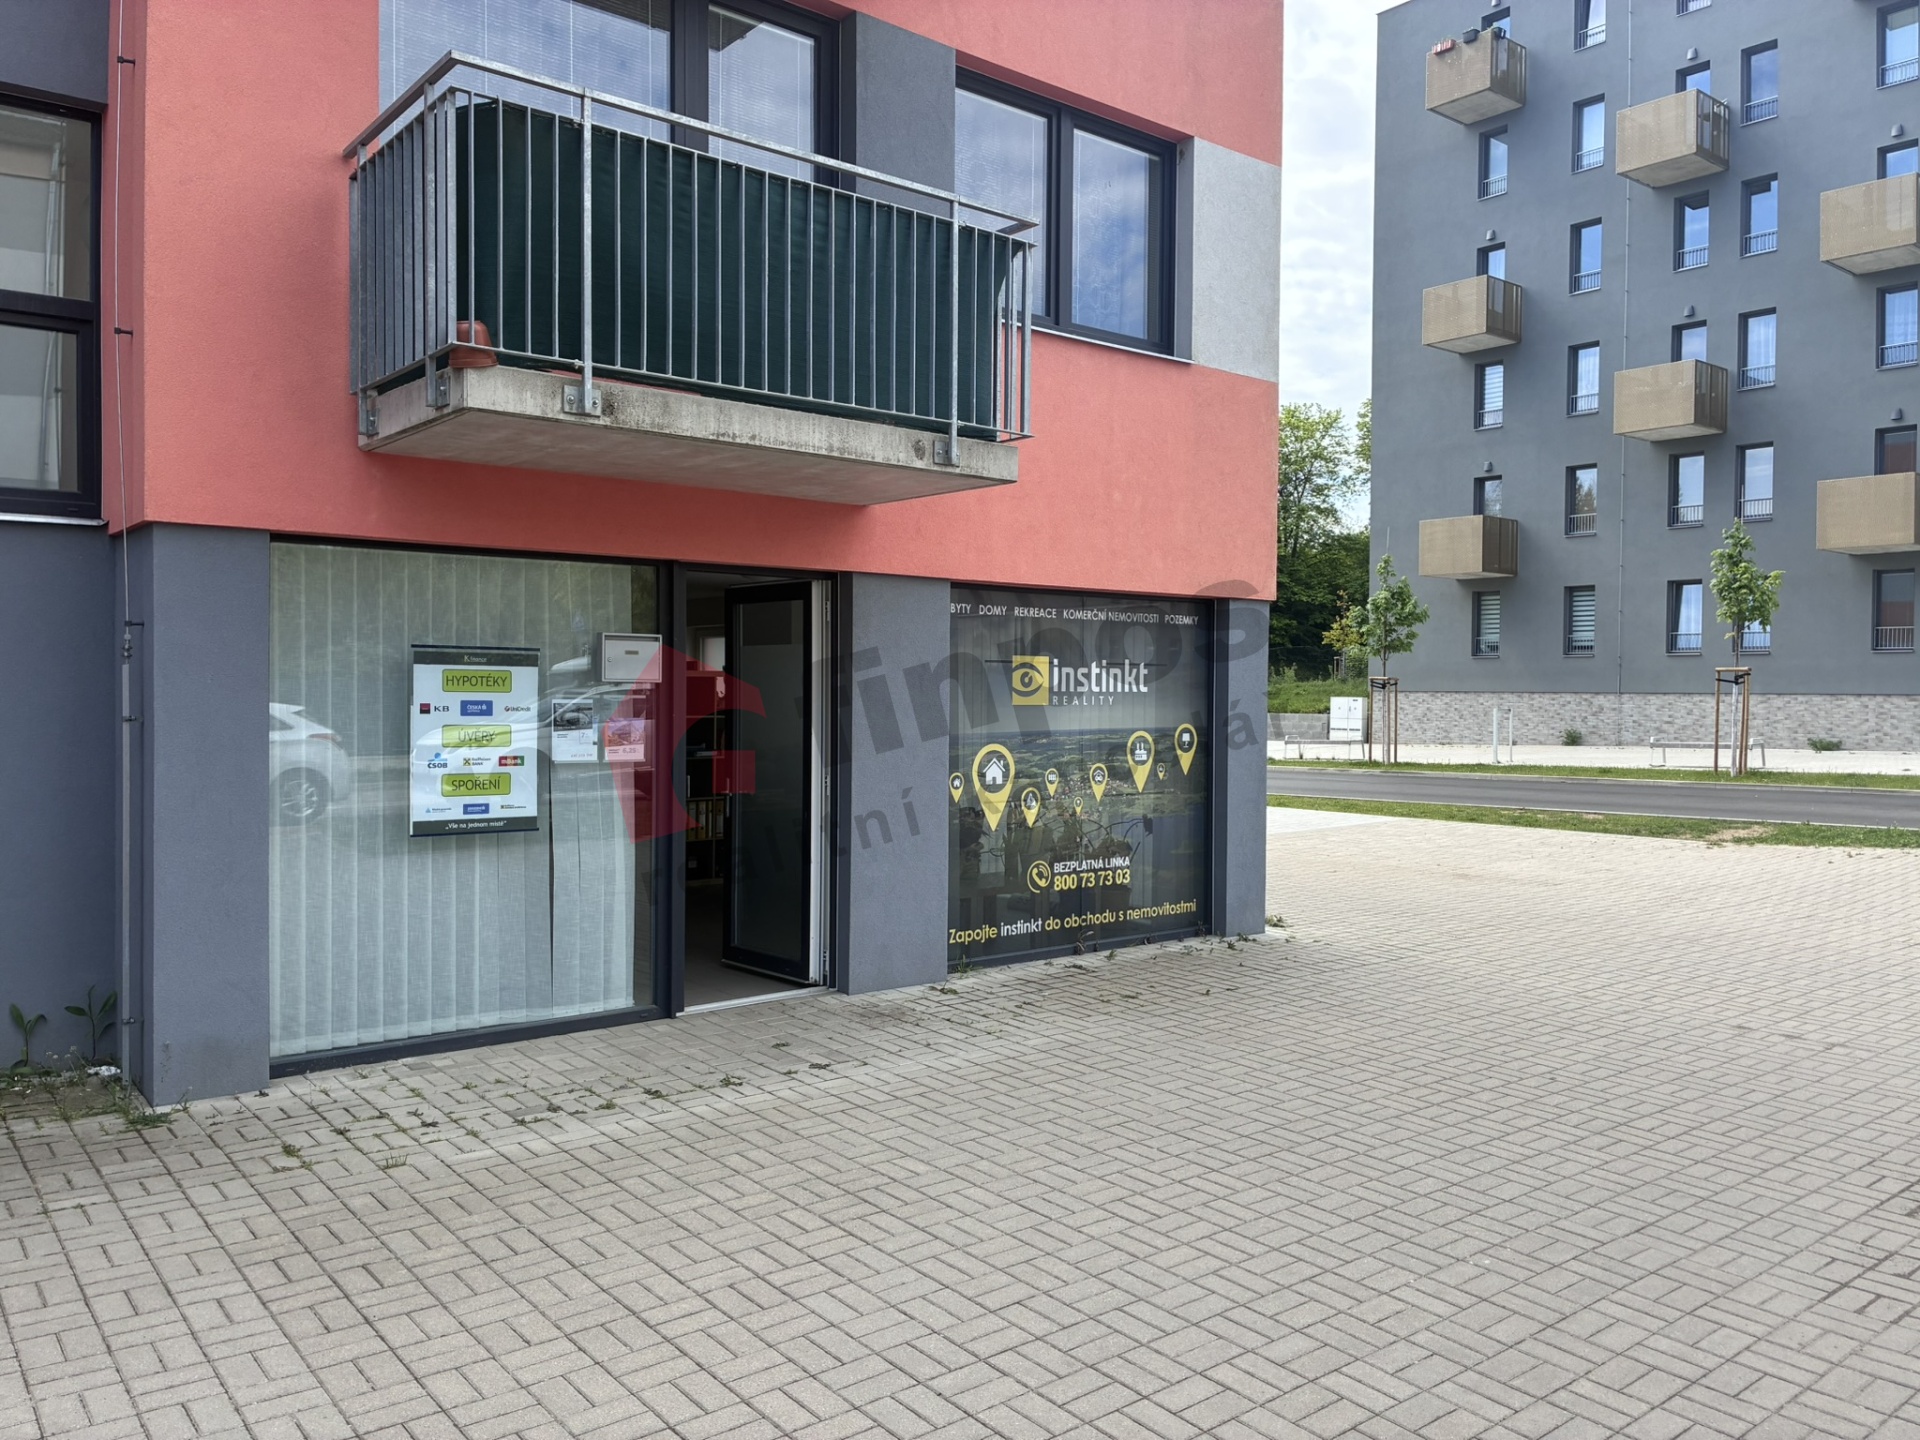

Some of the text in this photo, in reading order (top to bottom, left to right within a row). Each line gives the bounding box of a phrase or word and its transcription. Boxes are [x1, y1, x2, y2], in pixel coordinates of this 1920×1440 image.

[950, 603, 1199, 625] BYTY DOMY REKREACE KOMERČNÍ NEMOVITOSTI POZEMKY
[446, 673, 508, 687] HYPOTÉKY
[1053, 658, 1149, 693] instinkt
[1053, 695, 1115, 706] REALITY
[434, 705, 450, 713] KB
[458, 728, 497, 743] ÚVĚRY
[451, 776, 501, 791] SPOŘENÍ
[467, 821, 489, 830] jednom
[1053, 856, 1131, 873] BEZPLATNÁ LINKA
[1053, 868, 1131, 891] 800 73 73 03
[949, 898, 1198, 945] Zapojte instinkt do obchodu s nemovitostmi
